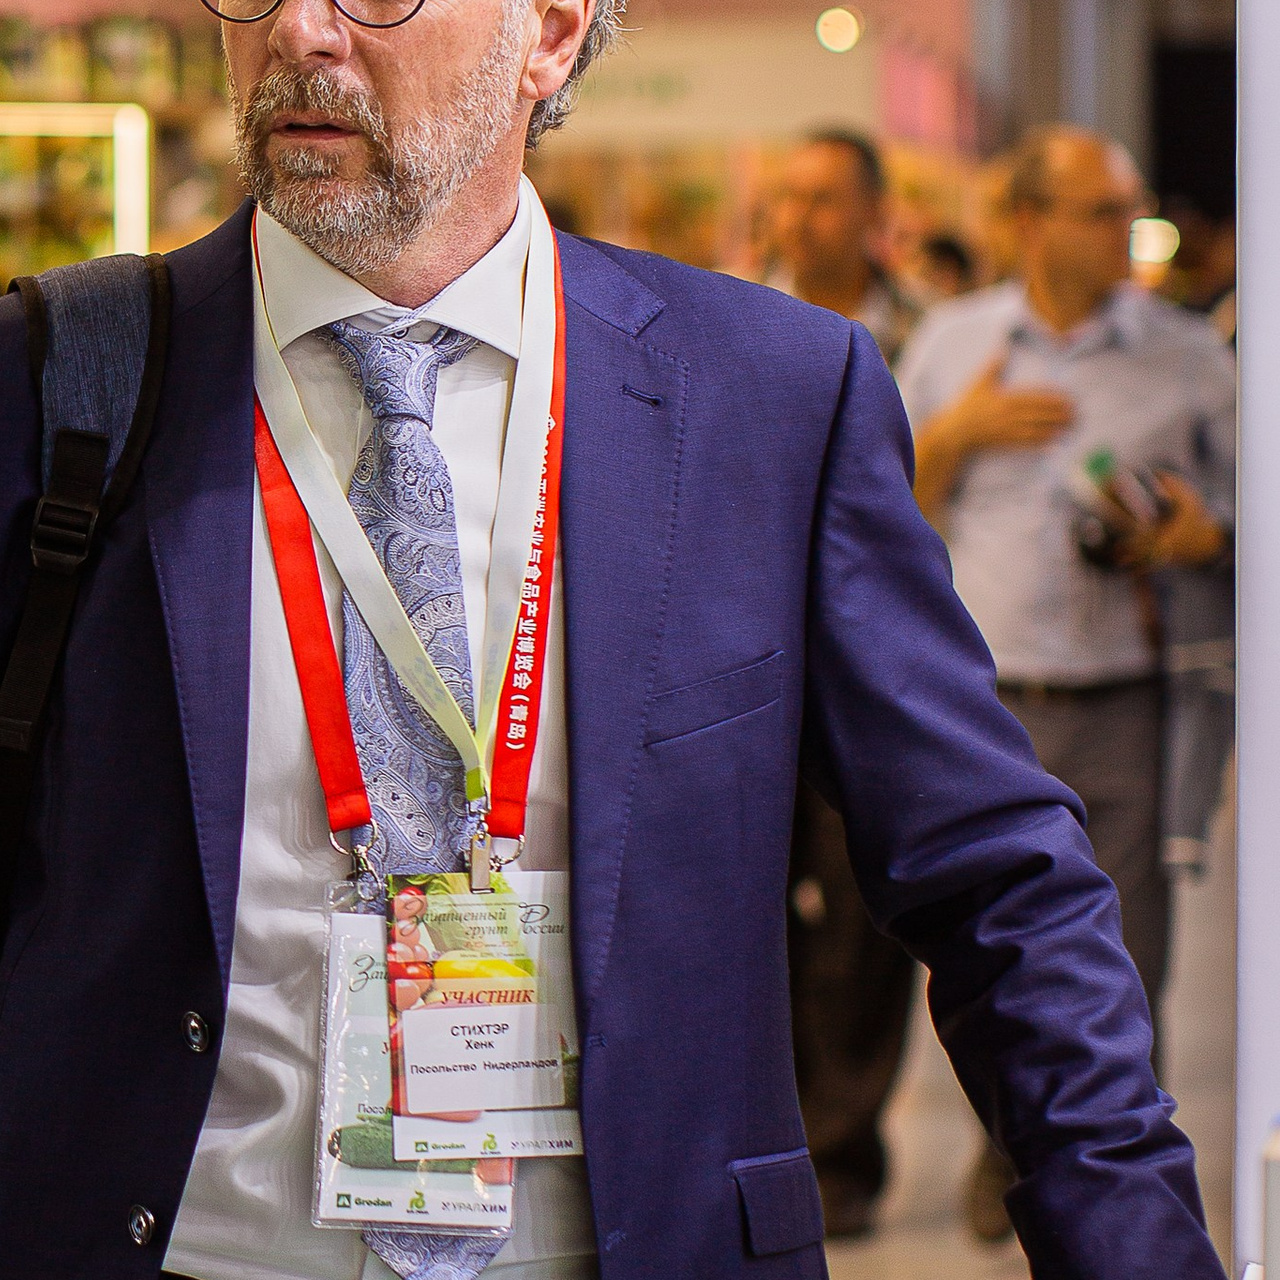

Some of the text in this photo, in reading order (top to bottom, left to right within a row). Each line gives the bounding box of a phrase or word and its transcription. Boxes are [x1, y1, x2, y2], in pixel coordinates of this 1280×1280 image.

[440, 989, 535, 1006] УЧАСТНИК
[450, 1023, 510, 1037] СТИХТЭР
[464, 1039, 496, 1051] Хенк
[410, 1058, 559, 1075] Посольство Нидерландов
[354, 1195, 393, 1208] Grodan
